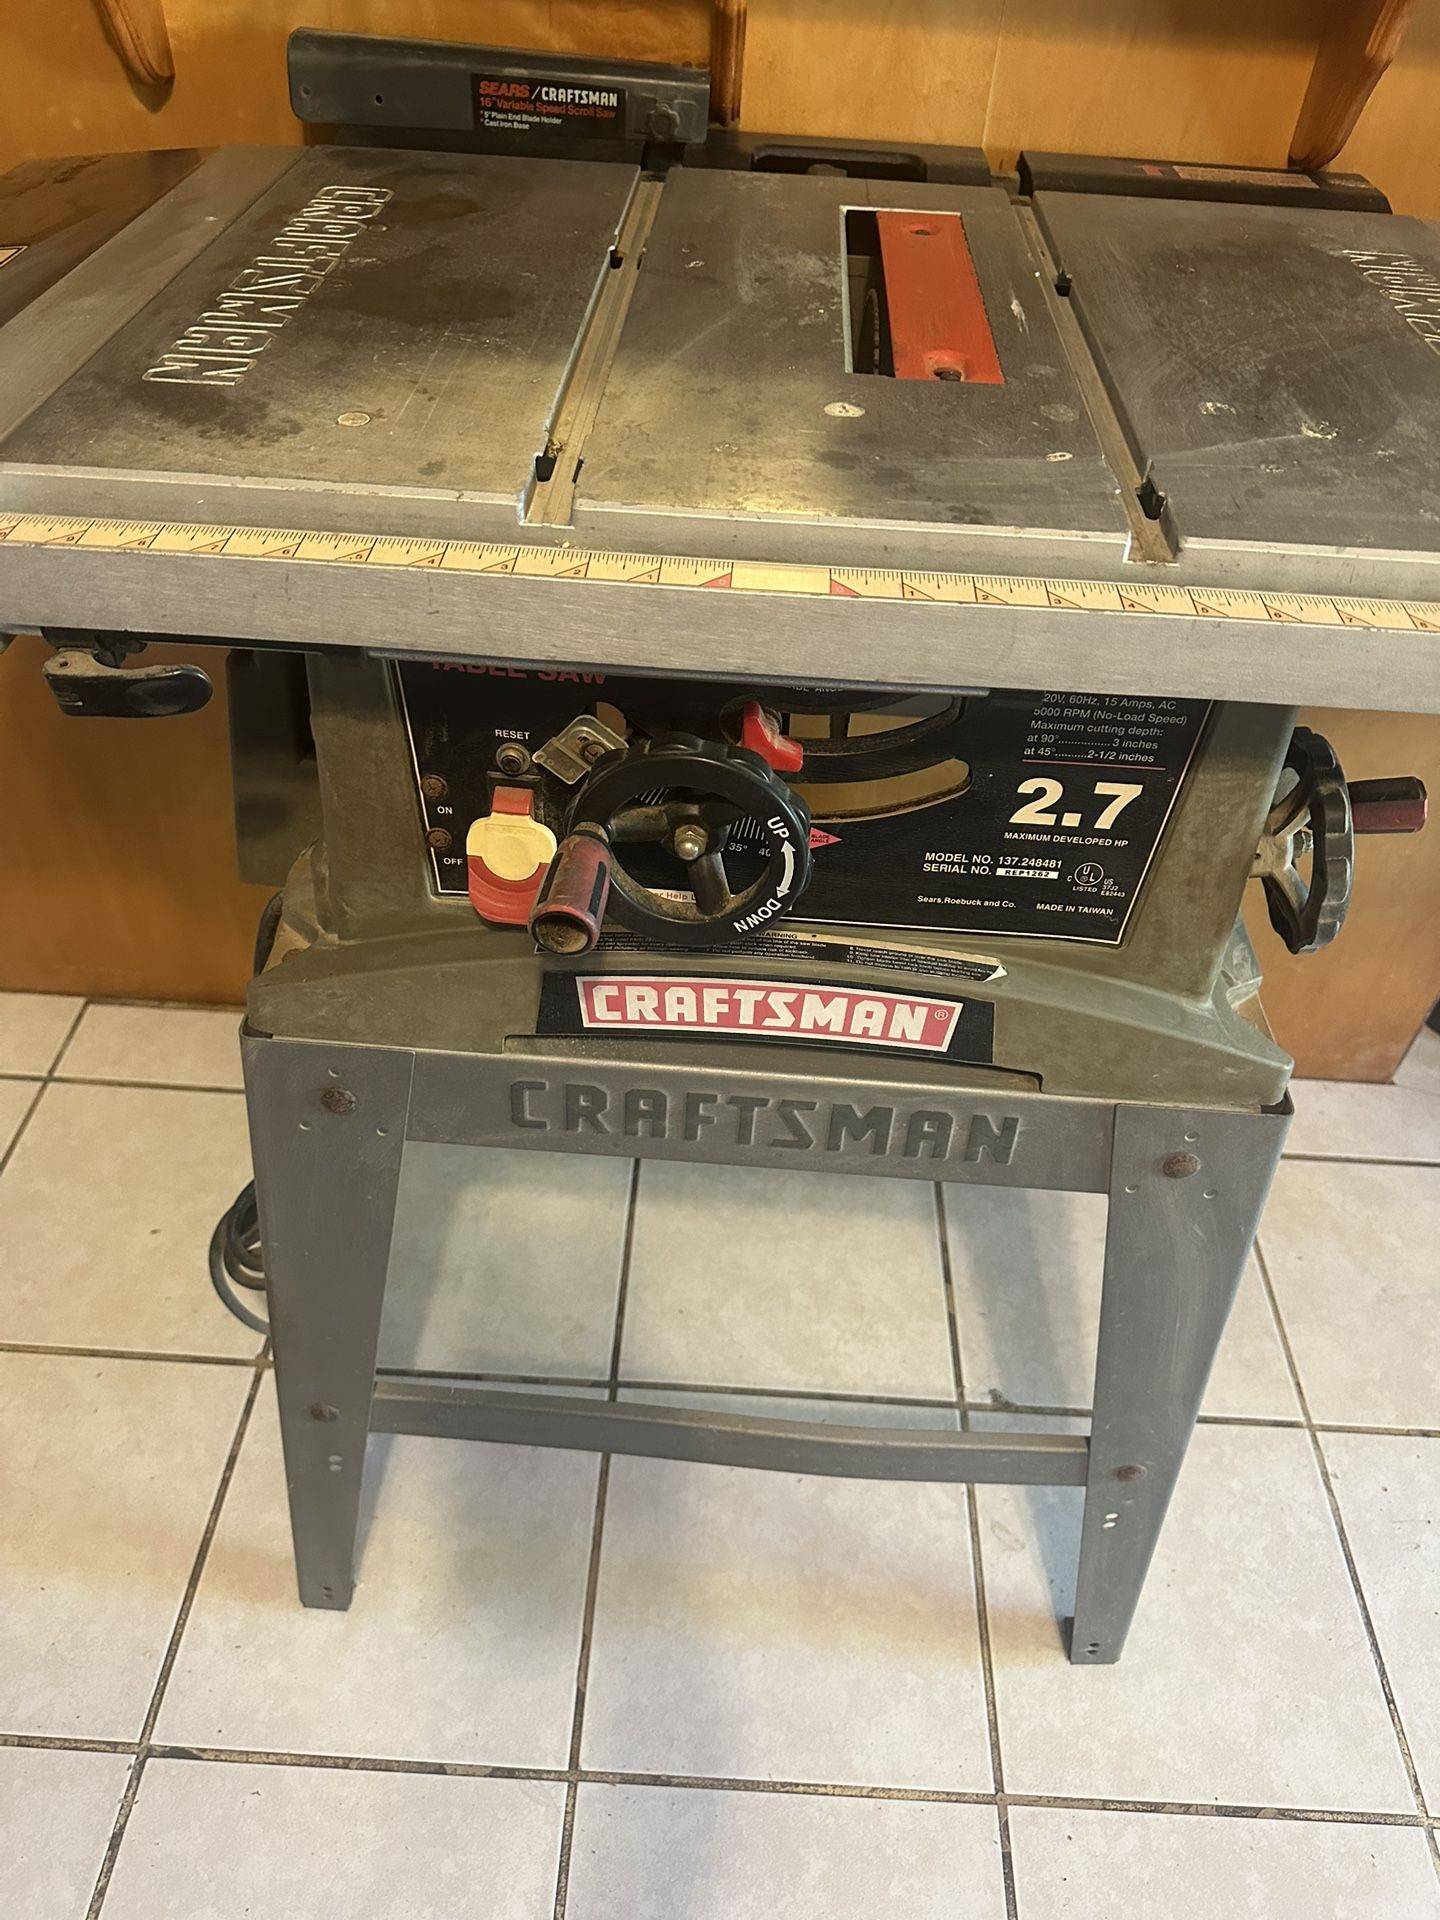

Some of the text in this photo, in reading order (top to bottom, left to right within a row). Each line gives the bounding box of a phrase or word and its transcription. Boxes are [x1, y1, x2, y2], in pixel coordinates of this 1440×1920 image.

[479, 81, 530, 97] SEARS
[496, 99, 534, 112] Variable
[536, 103, 566, 115] Speed
[568, 105, 595, 117] Scroll
[596, 108, 617, 119] Saw
[1042, 693, 1065, 704] 20V,
[1105, 697, 1117, 706] 15
[1120, 698, 1154, 710] Amps,
[1158, 700, 1177, 710] AC
[1033, 707, 1188, 726] 5000 RPM (No-Load Speed)
[495, 729, 530, 740] RESET
[1030, 720, 1164, 738] Maximum cutting depth:
[1027, 734, 1040, 742] at
[1122, 739, 1158, 750] inches
[1024, 747, 1037, 755] at
[1118, 751, 1155, 763] inches
[437, 806, 453, 815] ON
[1008, 777, 1144, 830] 2.7
[767, 816, 790, 838] UP
[1004, 832, 1129, 848] MAXIMUM DEVELOPED HP
[443, 857, 463, 866] OFF
[925, 852, 1063, 869] MODEL NO. 137.248481
[923, 863, 1051, 878] SERIAL NO. REP1262
[666, 892, 688, 901] Help
[983, 899, 1000, 907] and
[1002, 900, 1017, 908] Co.
[733, 898, 782, 933] DOWN
[1036, 903, 1064, 912] MADE
[1078, 906, 1114, 916] TAIWAN
[592, 983, 929, 1041] CRAFTSMAN
[509, 1081, 1022, 1165] CRAFTSMAN
